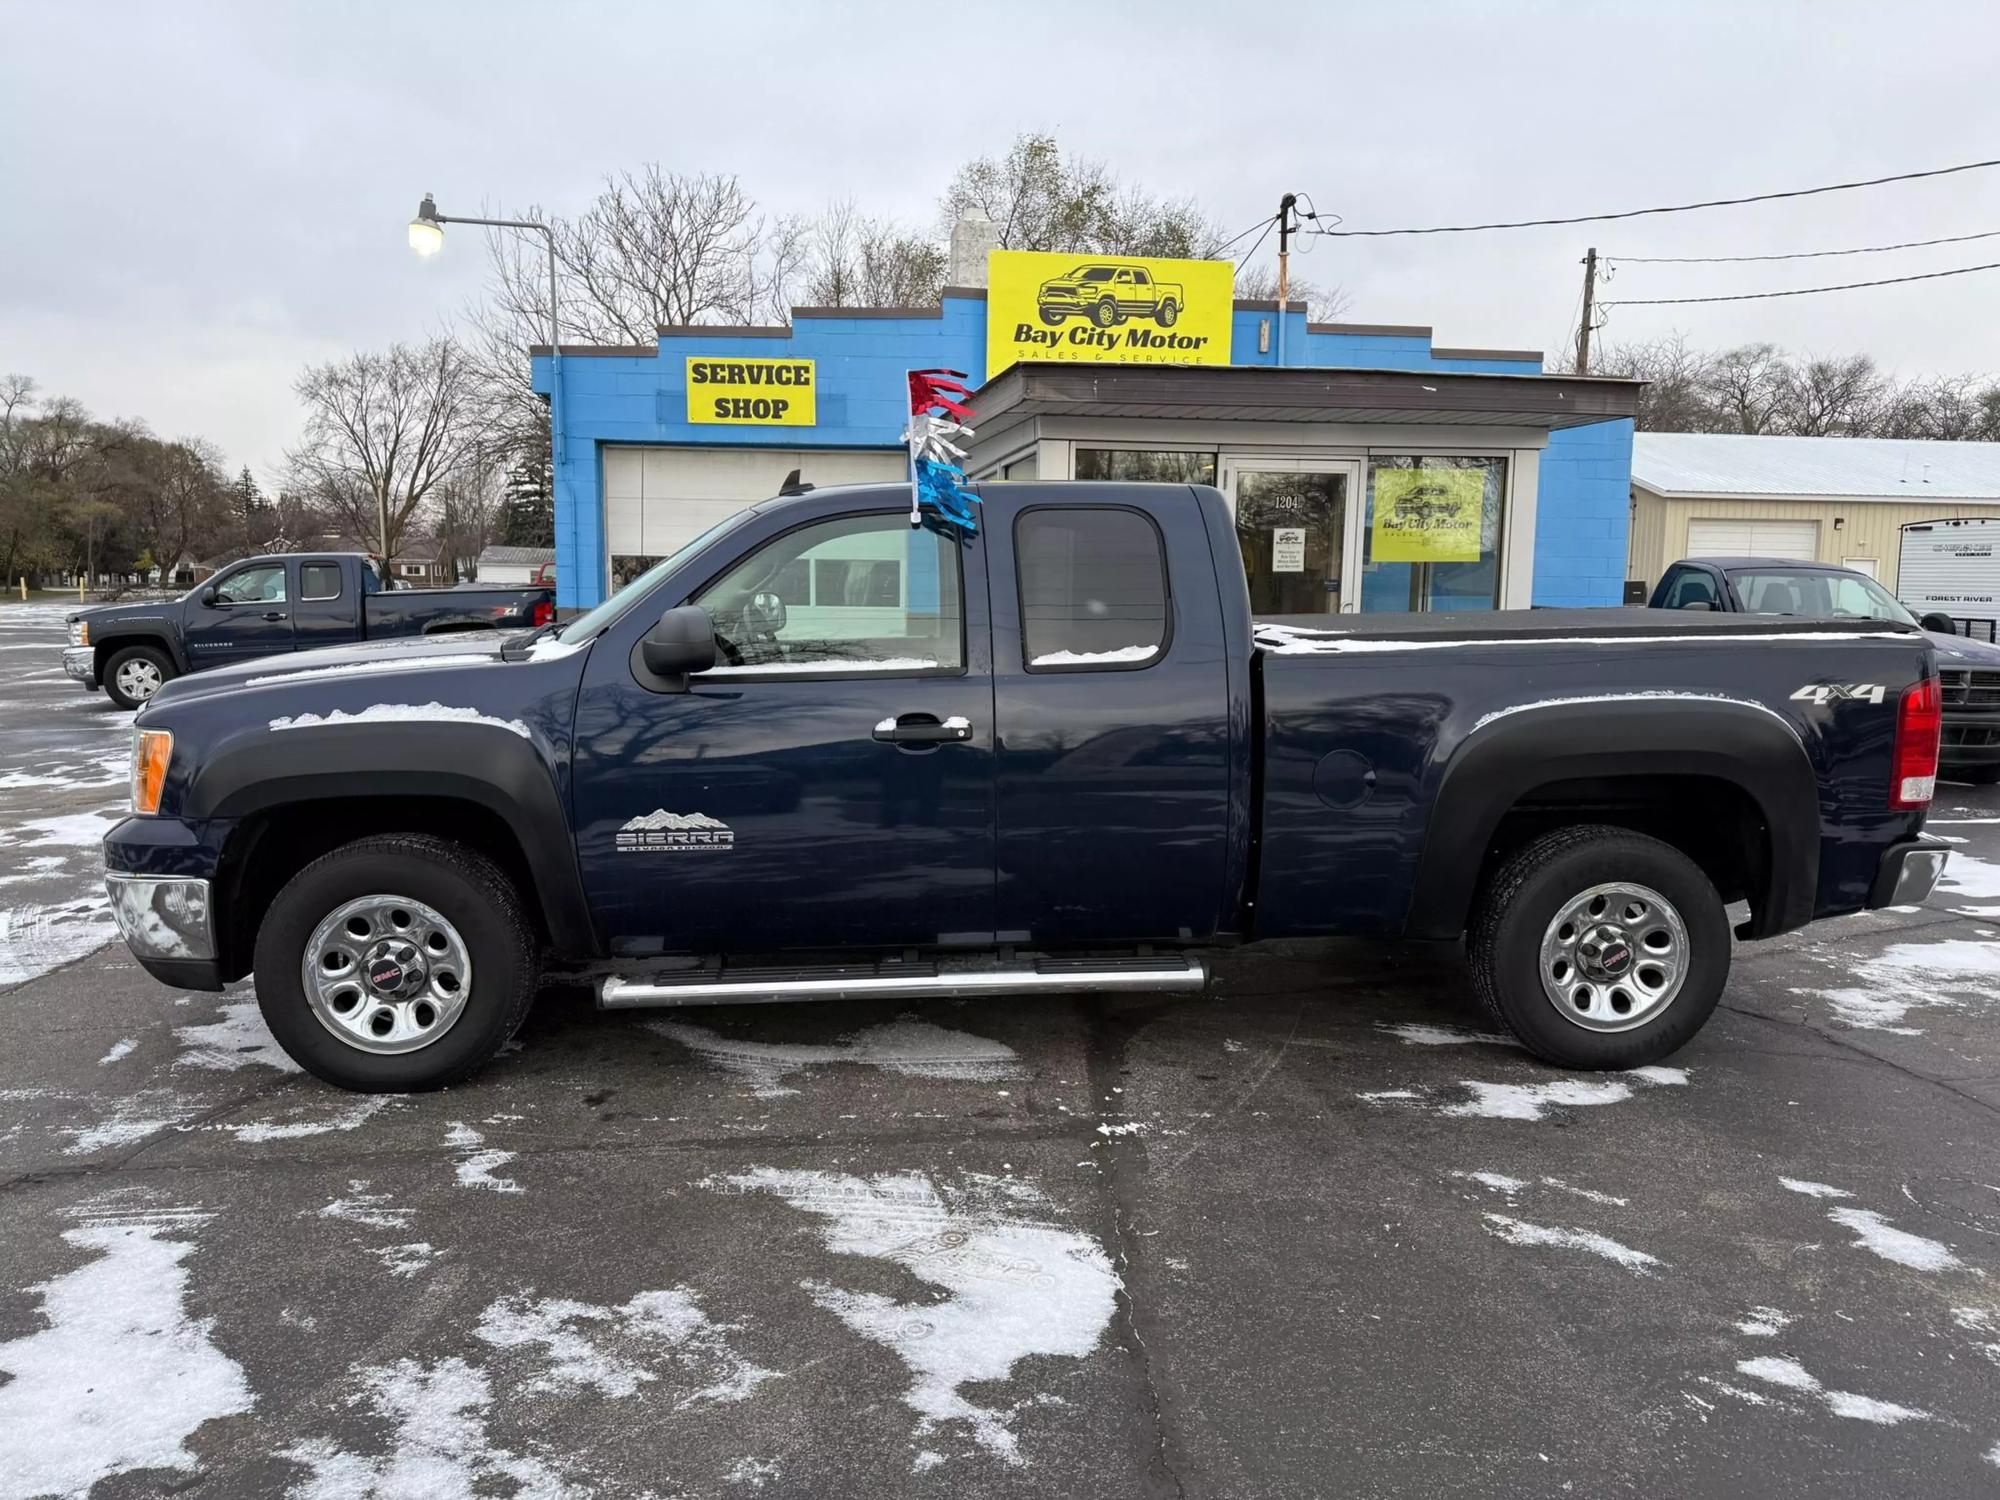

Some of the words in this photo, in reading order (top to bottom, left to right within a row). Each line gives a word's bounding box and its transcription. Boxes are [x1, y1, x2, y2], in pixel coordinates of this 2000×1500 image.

[1013, 324, 1064, 348] Bay
[1068, 325, 1121, 350] City
[1125, 328, 1208, 350] Motor
[1018, 350, 1078, 360] SALES
[1095, 353, 1103, 361] &
[1120, 353, 1203, 364] SERVICE
[691, 363, 810, 386] SERVICE
[714, 397, 789, 419] SHOP
[1275, 495, 1298, 509] 1204
[1383, 518, 1407, 532] Bay
[1408, 518, 1433, 531] City
[1433, 518, 1473, 530] Motor
[1963, 595, 1993, 603] RIVER
[615, 831, 735, 846] SIERRA
[372, 967, 401, 984] GMC
